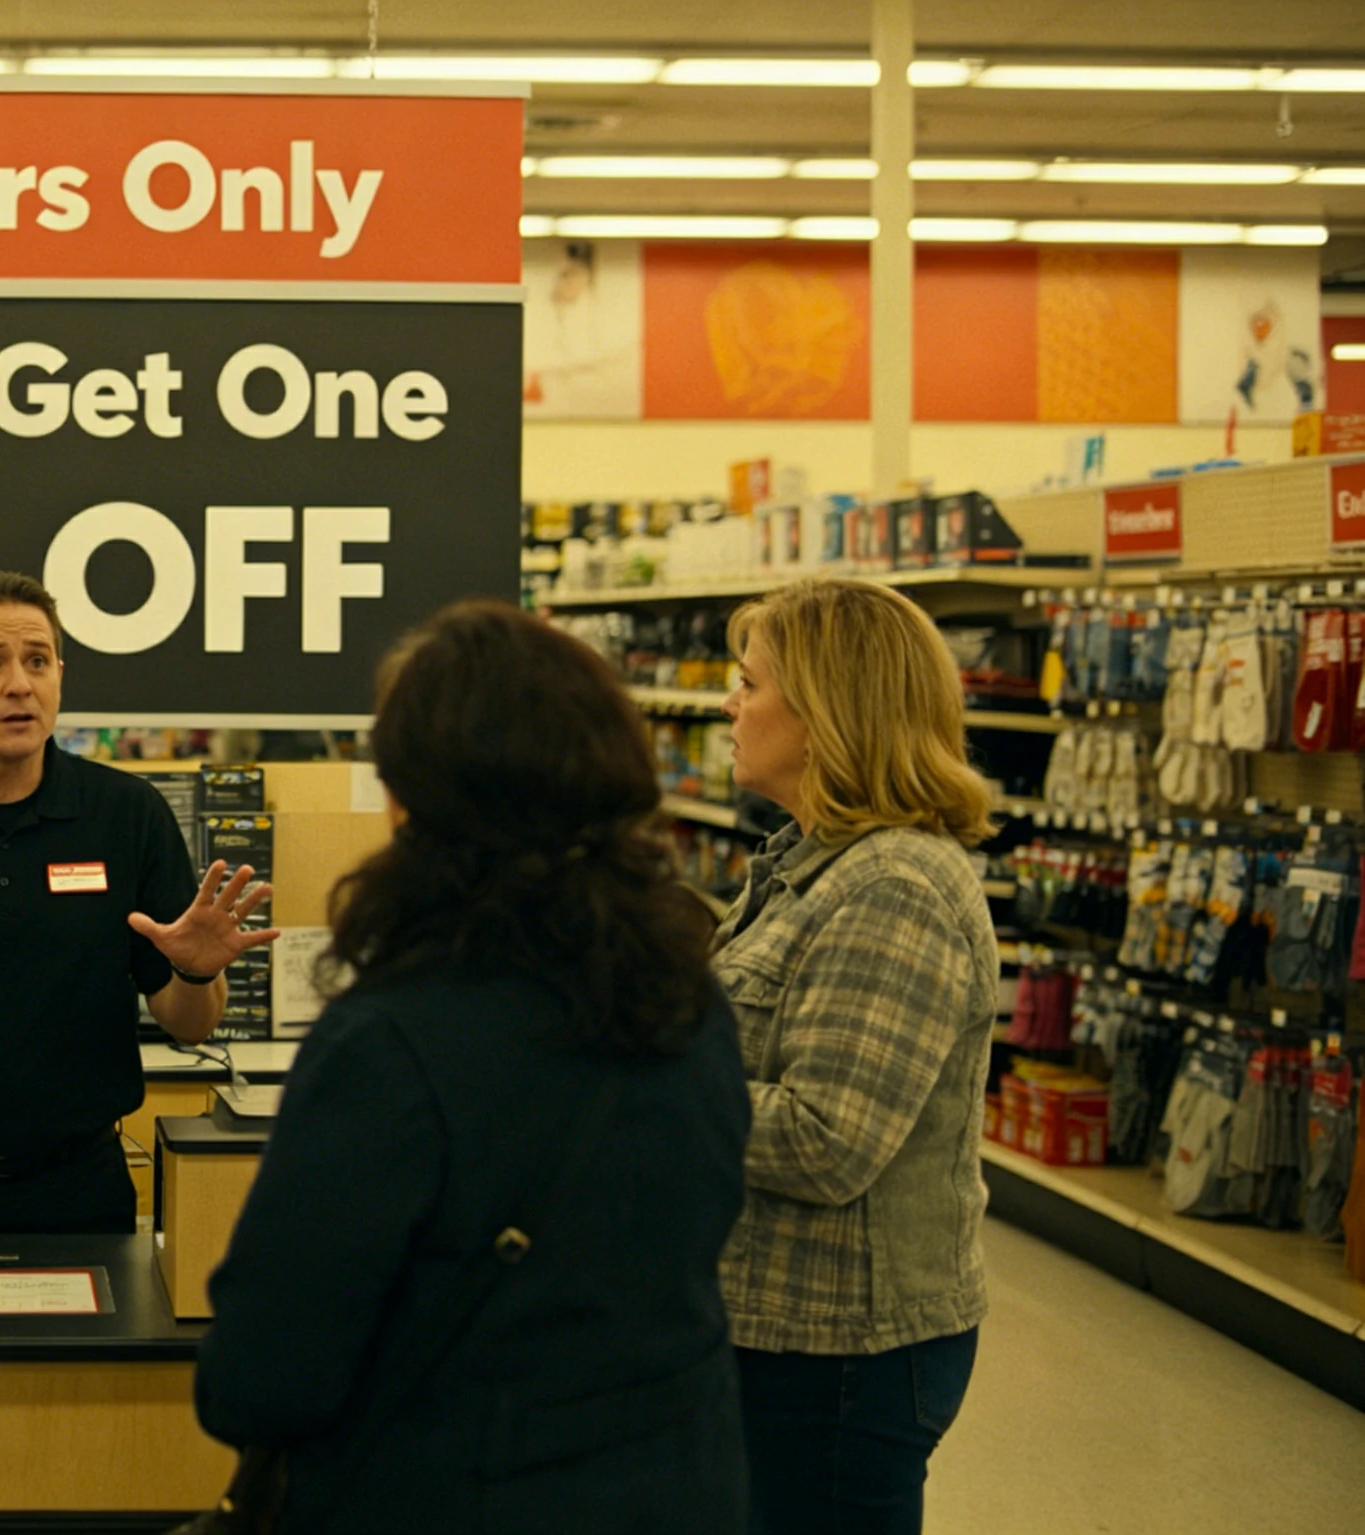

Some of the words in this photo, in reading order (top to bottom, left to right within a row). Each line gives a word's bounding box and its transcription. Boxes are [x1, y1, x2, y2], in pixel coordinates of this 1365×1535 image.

[122, 140, 384, 258] Only
[216, 344, 449, 441] One
[42, 501, 391, 654] OFF
